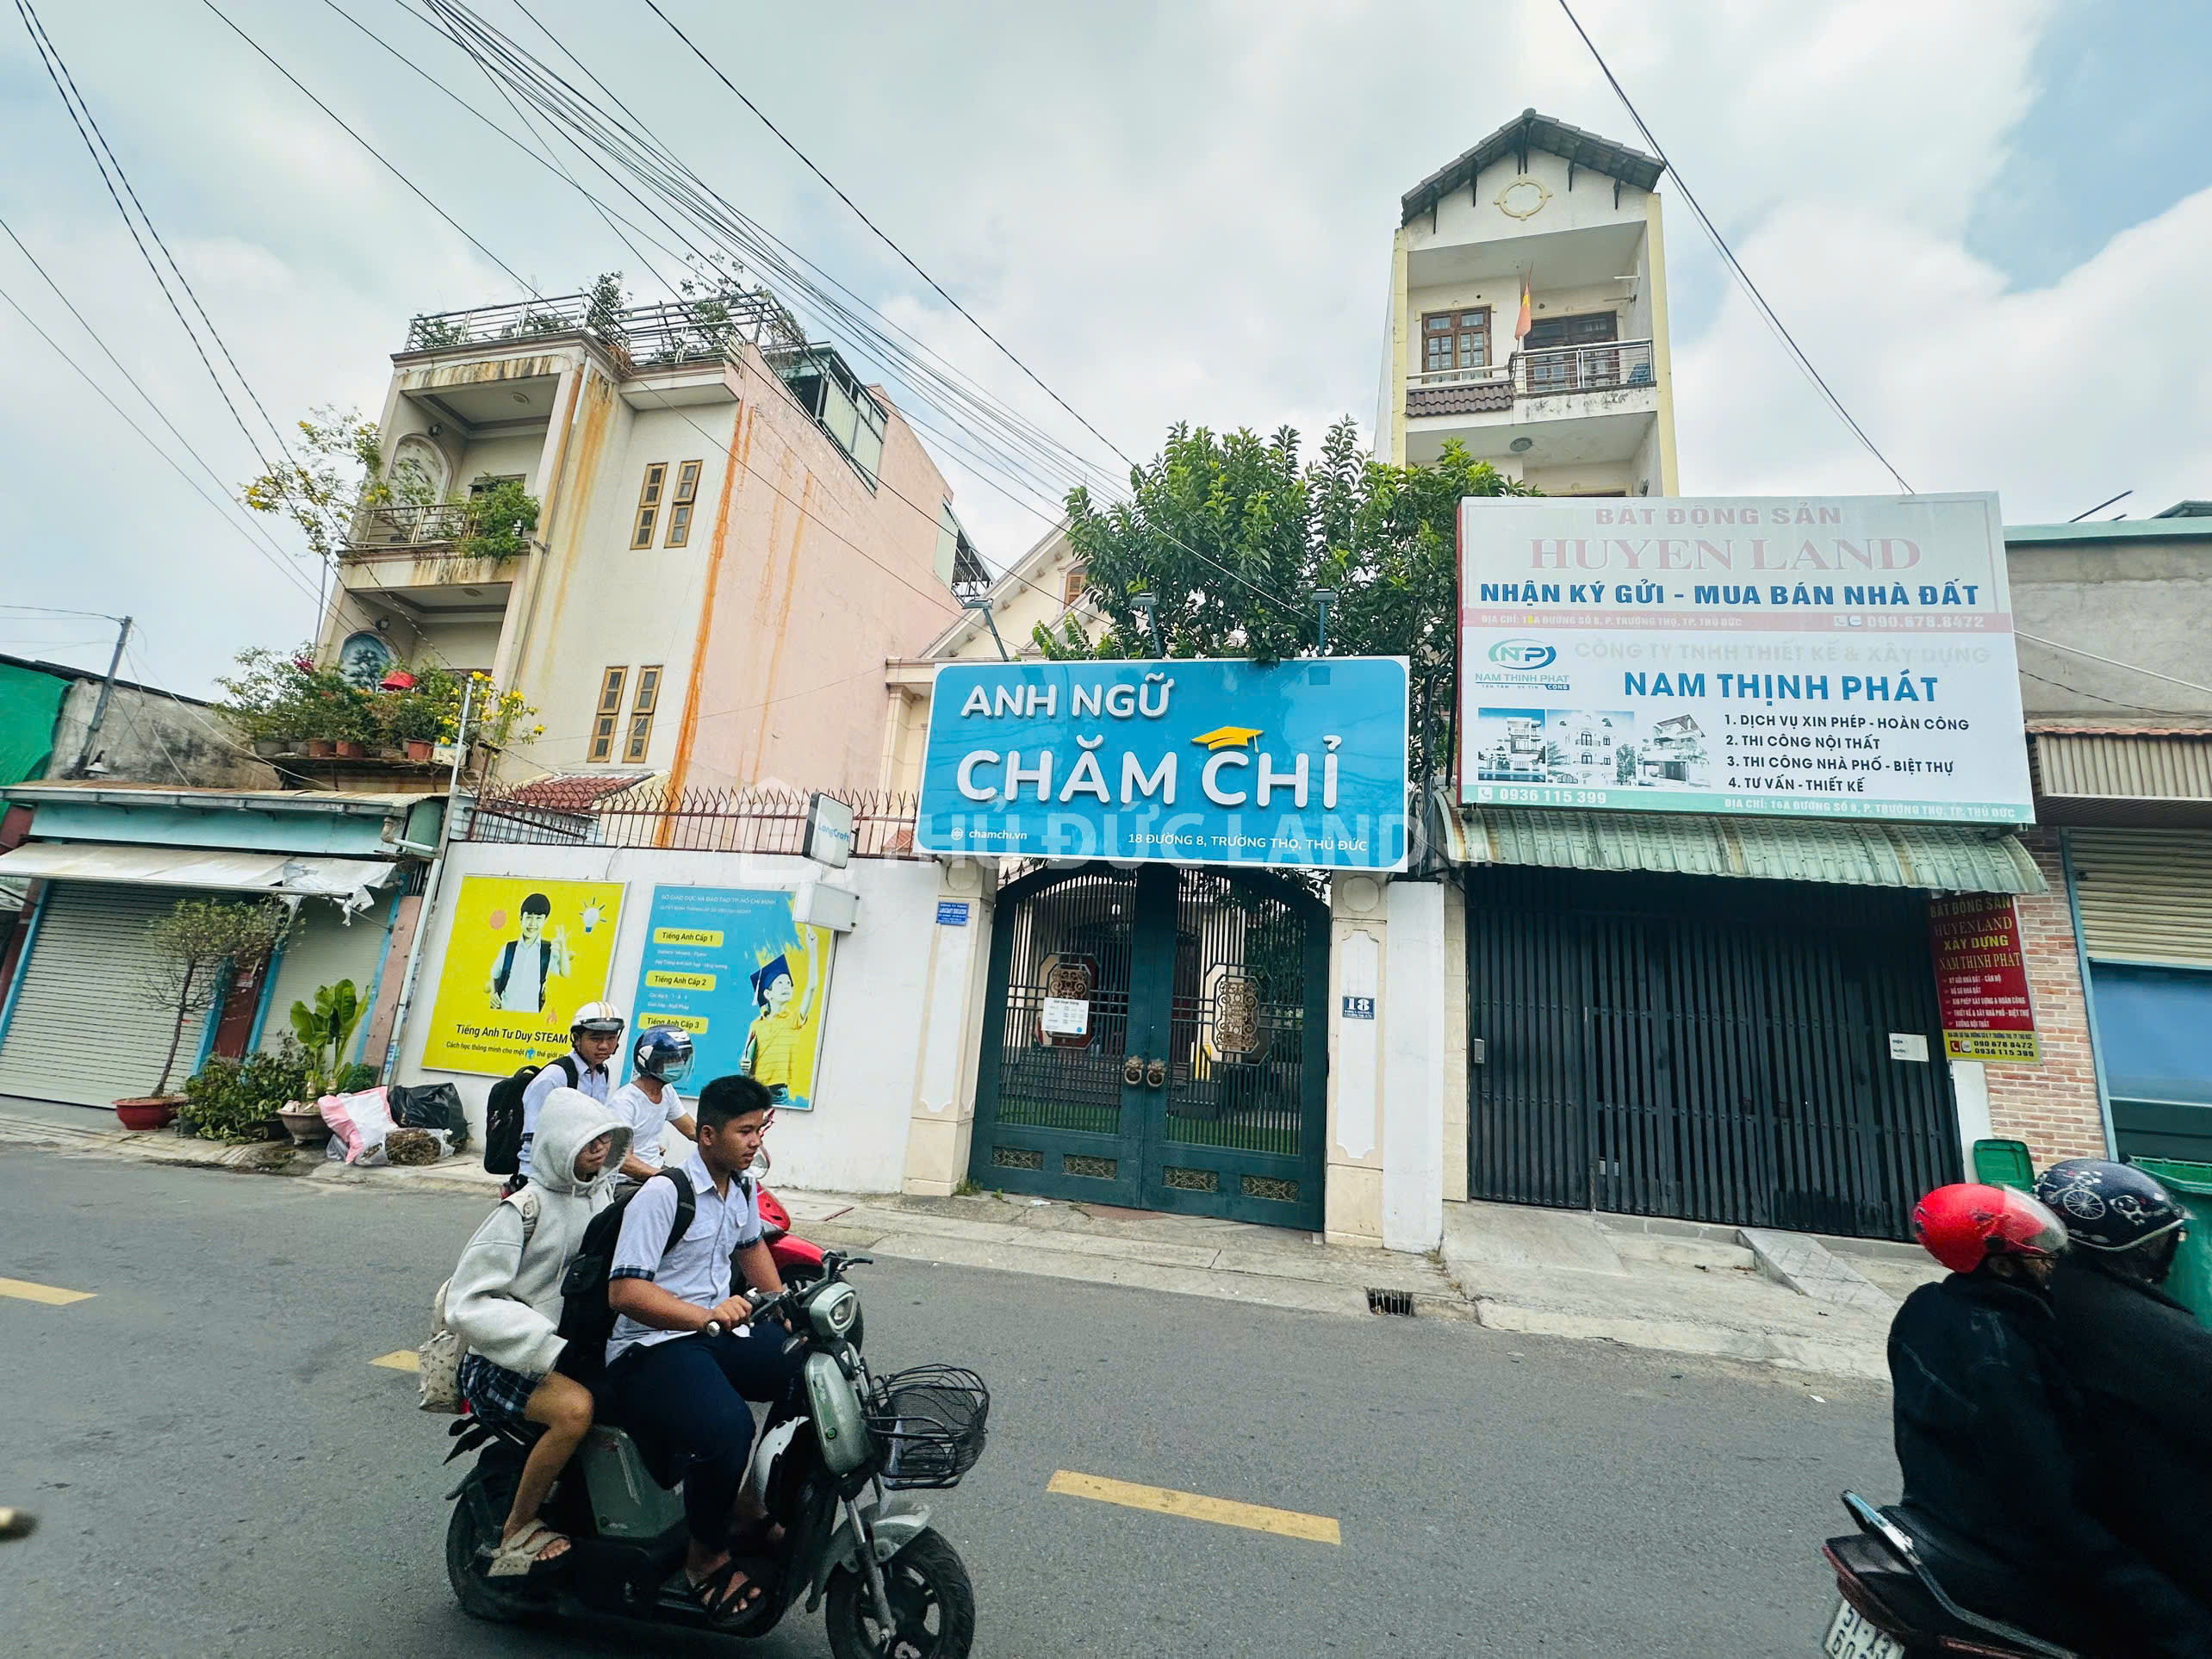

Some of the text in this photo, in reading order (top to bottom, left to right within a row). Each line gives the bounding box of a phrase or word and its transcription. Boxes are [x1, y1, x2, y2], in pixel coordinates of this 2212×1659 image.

[1667, 504, 1759, 528] ĐỘNG
[1770, 502, 1842, 525] SẢN
[1749, 537, 1922, 570] LAND
[1481, 580, 1560, 606] NHẬN
[1569, 581, 1606, 603] KÝ
[1615, 579, 1664, 604] GỬI
[1694, 585, 1761, 604] MUA
[1770, 581, 1833, 605] BÁN
[1844, 581, 1910, 606] NHÀ
[1918, 579, 1979, 605] ĐẤT
[1650, 643, 1671, 659] TY
[1680, 643, 1737, 661] TNHH
[1476, 673, 1501, 681] NAM
[1504, 674, 1538, 682] THINH
[1625, 668, 1938, 705] NAM THỊNH PHÁT
[960, 672, 1175, 718] ANH NGỮ
[1724, 714, 1737, 725] 1.
[1740, 715, 1775, 729] DỊCH
[1780, 716, 1799, 729] VỤ
[1803, 716, 1827, 727] XIN
[1830, 715, 1866, 728] PHÉP
[1878, 716, 1920, 730] HOÀN
[1924, 717, 1969, 730] CÔNG
[1726, 734, 1880, 751] 2. THI CÔNG NỘI THẤT
[957, 734, 1342, 810] CHĂM CHỈ
[1727, 755, 1739, 767] 3.
[1743, 756, 1765, 767] THI
[1768, 756, 1812, 769] CÔNG
[1817, 756, 1848, 770] NHÀ
[1852, 755, 1882, 771] PHỐ
[1894, 760, 1922, 775] BIỆT
[1926, 761, 1954, 775] THỰ
[1728, 777, 1741, 788] 4.
[1744, 777, 1762, 788] TƯ
[1765, 774, 1794, 790] VẤN
[1805, 777, 1842, 792] THIẾT
[1847, 777, 1866, 792] KẾ
[1500, 787, 1606, 804] 0936 115 399
[1724, 798, 1743, 809] ĐỊA
[969, 830, 1028, 841] chamchi.vn
[1128, 833, 1368, 851] 18 ĐƯỜNG 8, TRƯỜNG THỌ, THỦ ĐỨC
[662, 931, 680, 941] Tiếng
[1970, 935, 2009, 950] DỰNG
[655, 975, 673, 985] Tiếng
[1347, 998, 1370, 1011] 18
[457, 1024, 569, 1044] Tiếng Anh Tư Duy STEAM
